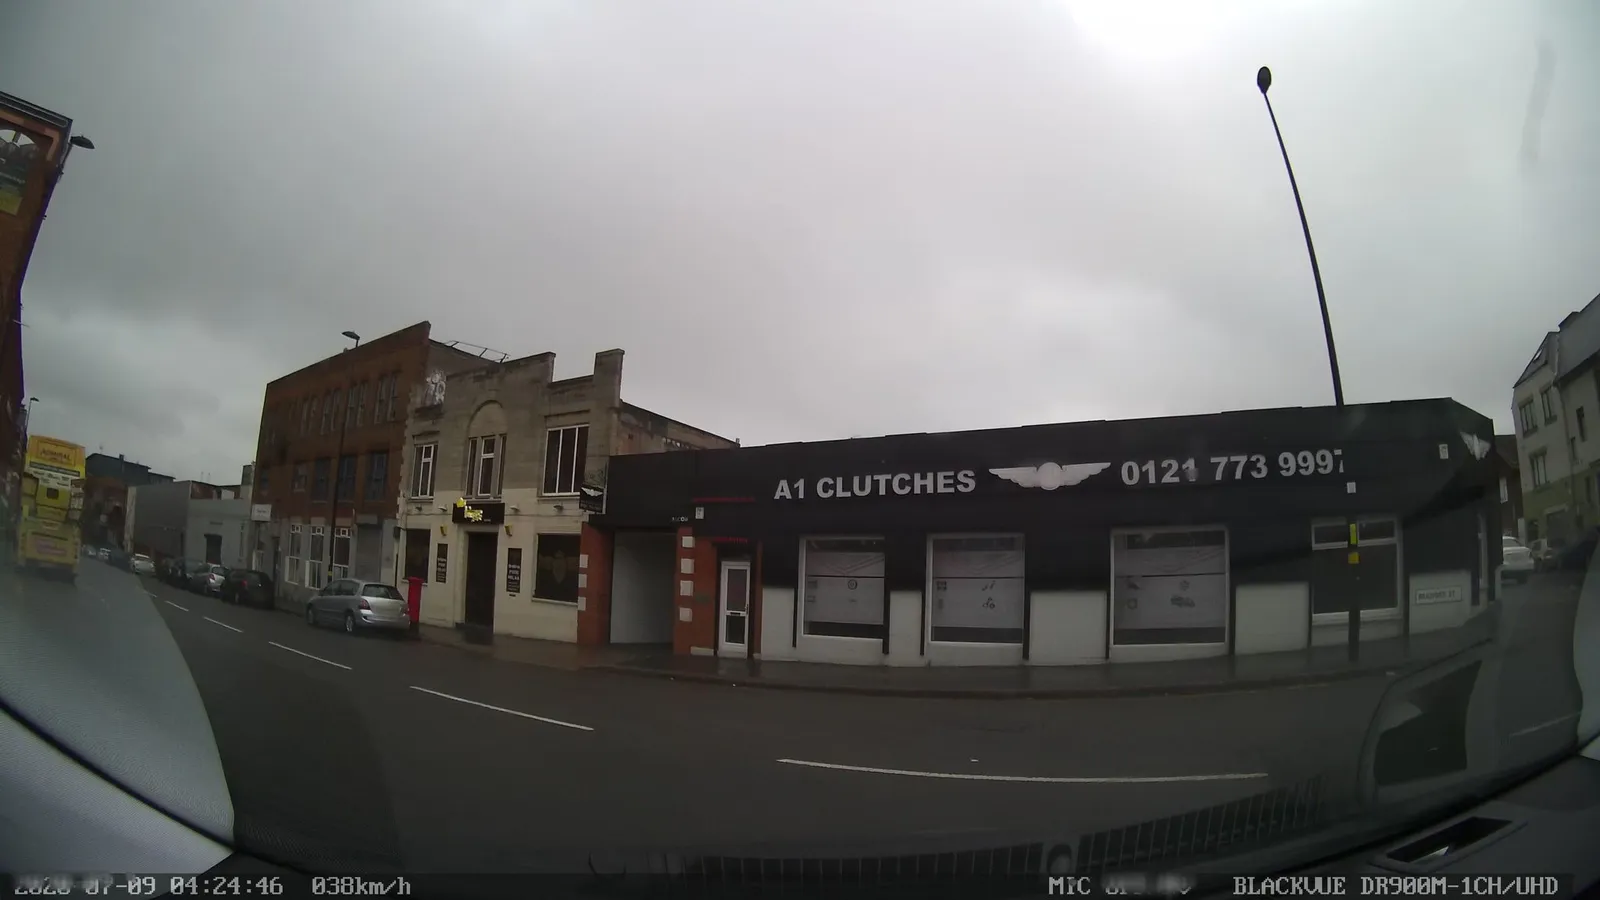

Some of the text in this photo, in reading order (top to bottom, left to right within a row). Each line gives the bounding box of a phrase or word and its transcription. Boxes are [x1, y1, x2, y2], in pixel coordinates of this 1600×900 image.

[1121, 457, 1197, 485] 0121
[1210, 454, 1268, 481] 773
[774, 470, 977, 500] A1 CLUTCHES
